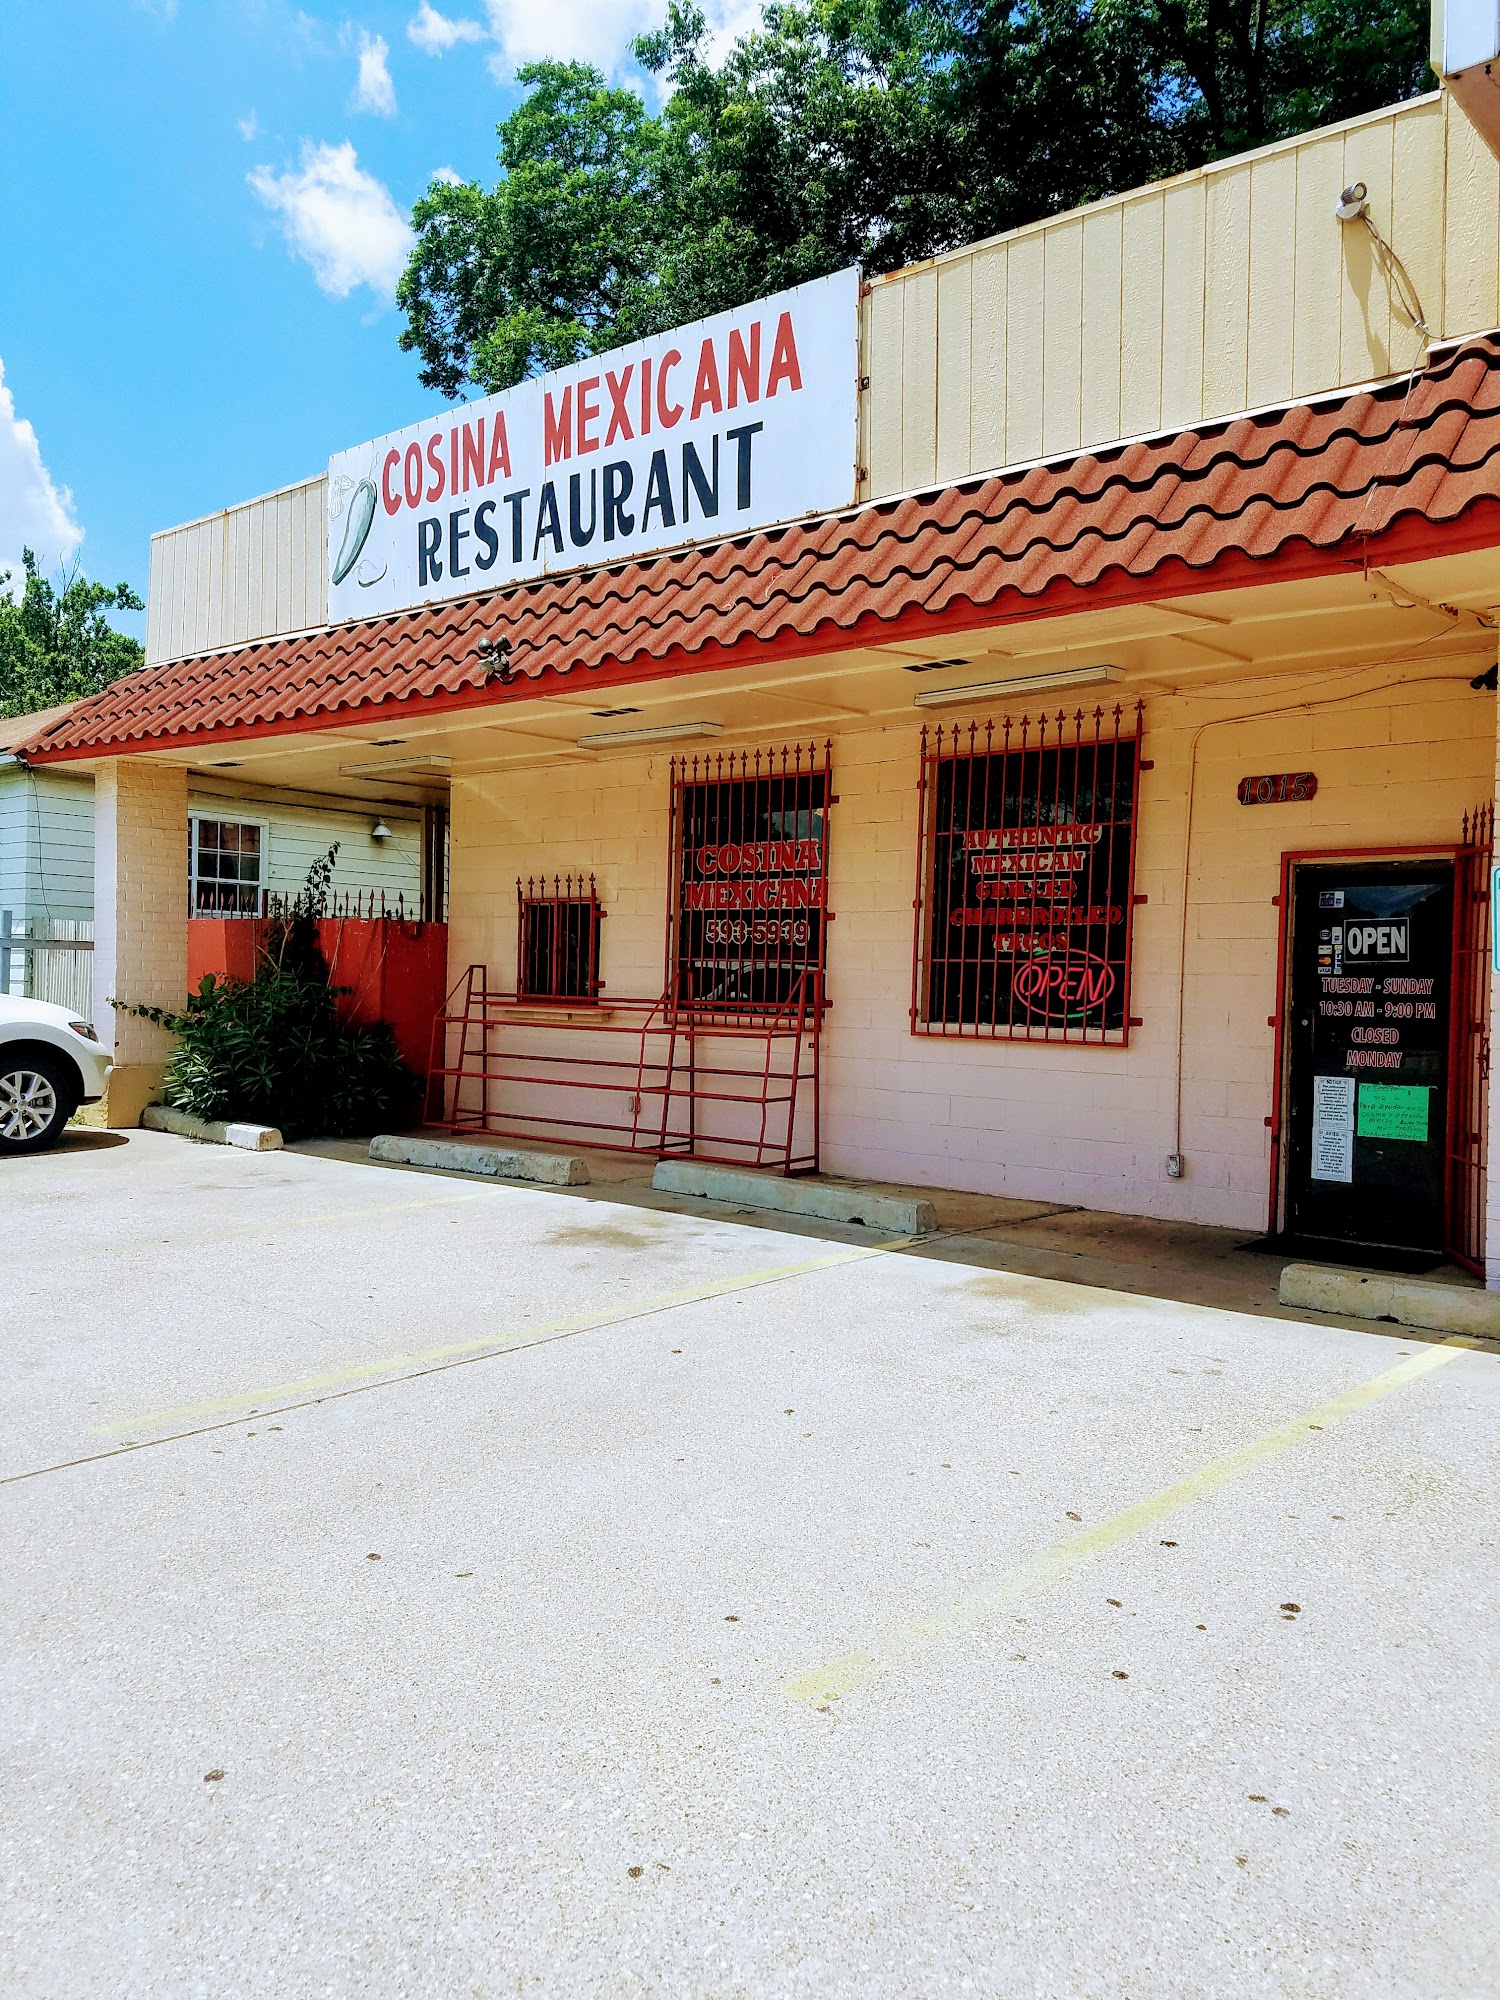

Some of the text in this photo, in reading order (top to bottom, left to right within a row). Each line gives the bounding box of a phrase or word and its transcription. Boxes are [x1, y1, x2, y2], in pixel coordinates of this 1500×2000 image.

[382, 312, 802, 515] COSINA MEXICANA
[418, 421, 763, 587] RESTAURANT
[1243, 774, 1308, 804] 1015
[962, 825, 1102, 850] AUTHENTIC
[697, 839, 820, 874] COSINA
[971, 851, 1086, 874] MEXICAN
[684, 877, 828, 910] MEXICANA
[976, 879, 1077, 900] GRILLED
[950, 905, 1124, 926] CHARBROILED
[706, 919, 810, 946] 593-5939
[992, 932, 1069, 953] TACOS
[1347, 926, 1406, 955] OPEN
[1019, 965, 1106, 1001] OPEN
[1322, 977, 1374, 994] TUESDAY
[1383, 978, 1434, 995] SUNDAY
[1319, 1001, 1353, 1017] 10:30
[1354, 1001, 1375, 1018] AM
[1384, 1002, 1413, 1018] 9:00
[1416, 1003, 1436, 1019] PM
[1351, 1027, 1400, 1045] CLOSED
[1346, 1050, 1403, 1068] MONDAY
